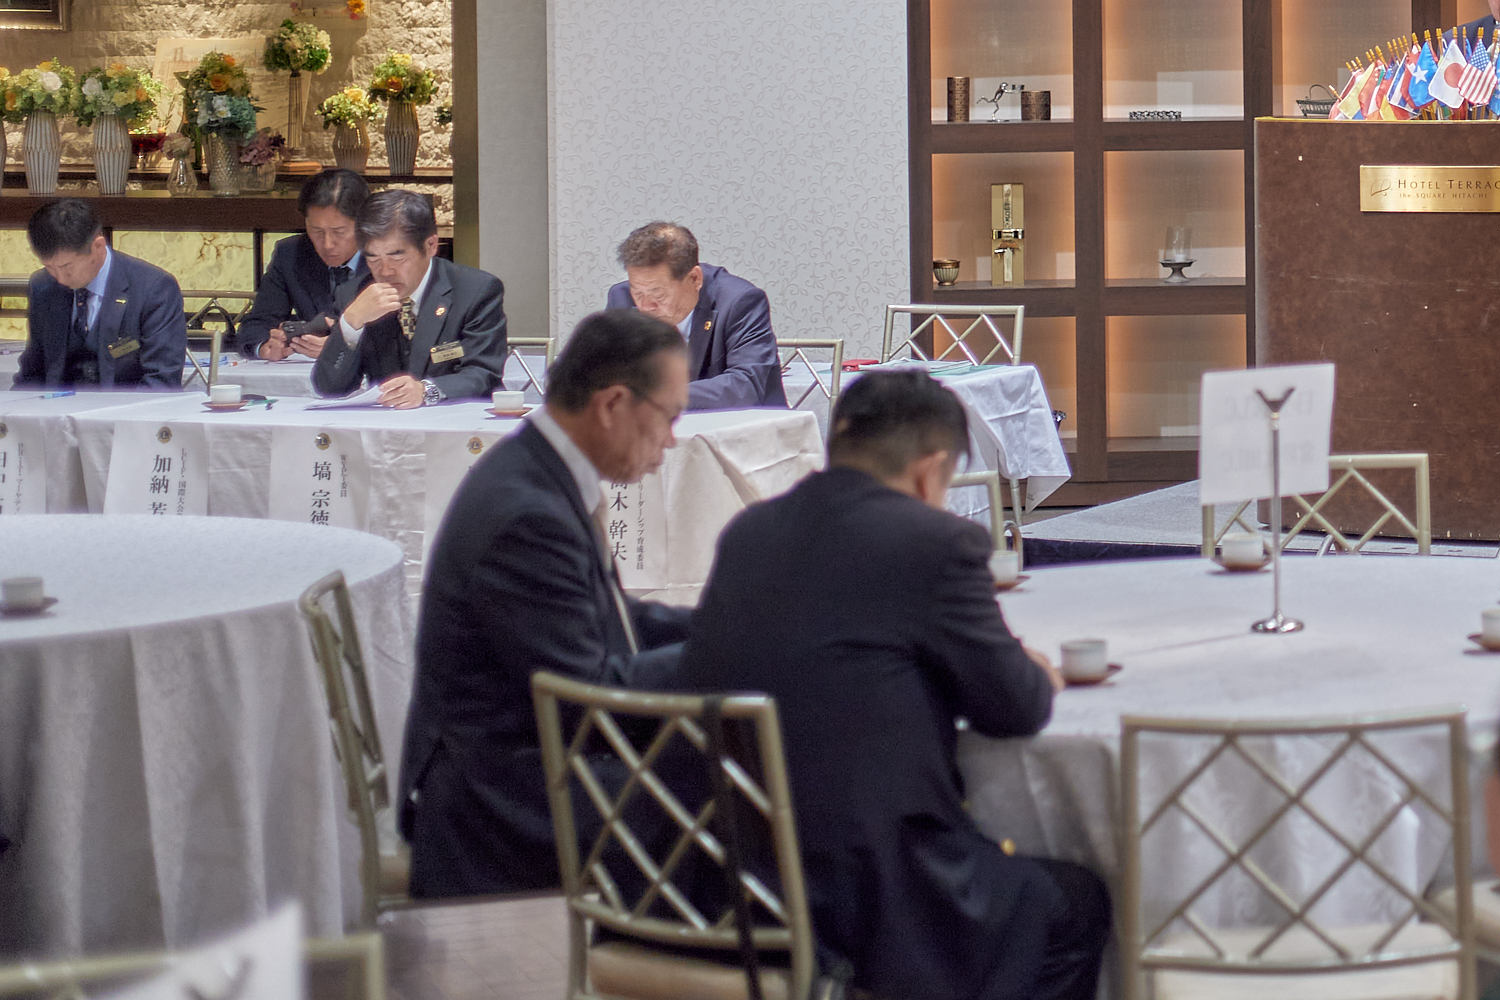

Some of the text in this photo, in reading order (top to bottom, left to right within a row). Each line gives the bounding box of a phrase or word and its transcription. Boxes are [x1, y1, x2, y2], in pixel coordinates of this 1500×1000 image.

[1398, 179, 1440, 189] HOTEL
[149, 454, 172, 494] 加納
[312, 461, 331, 481] 塙
[636, 481, 645, 570] リーダーシップ育成委員
